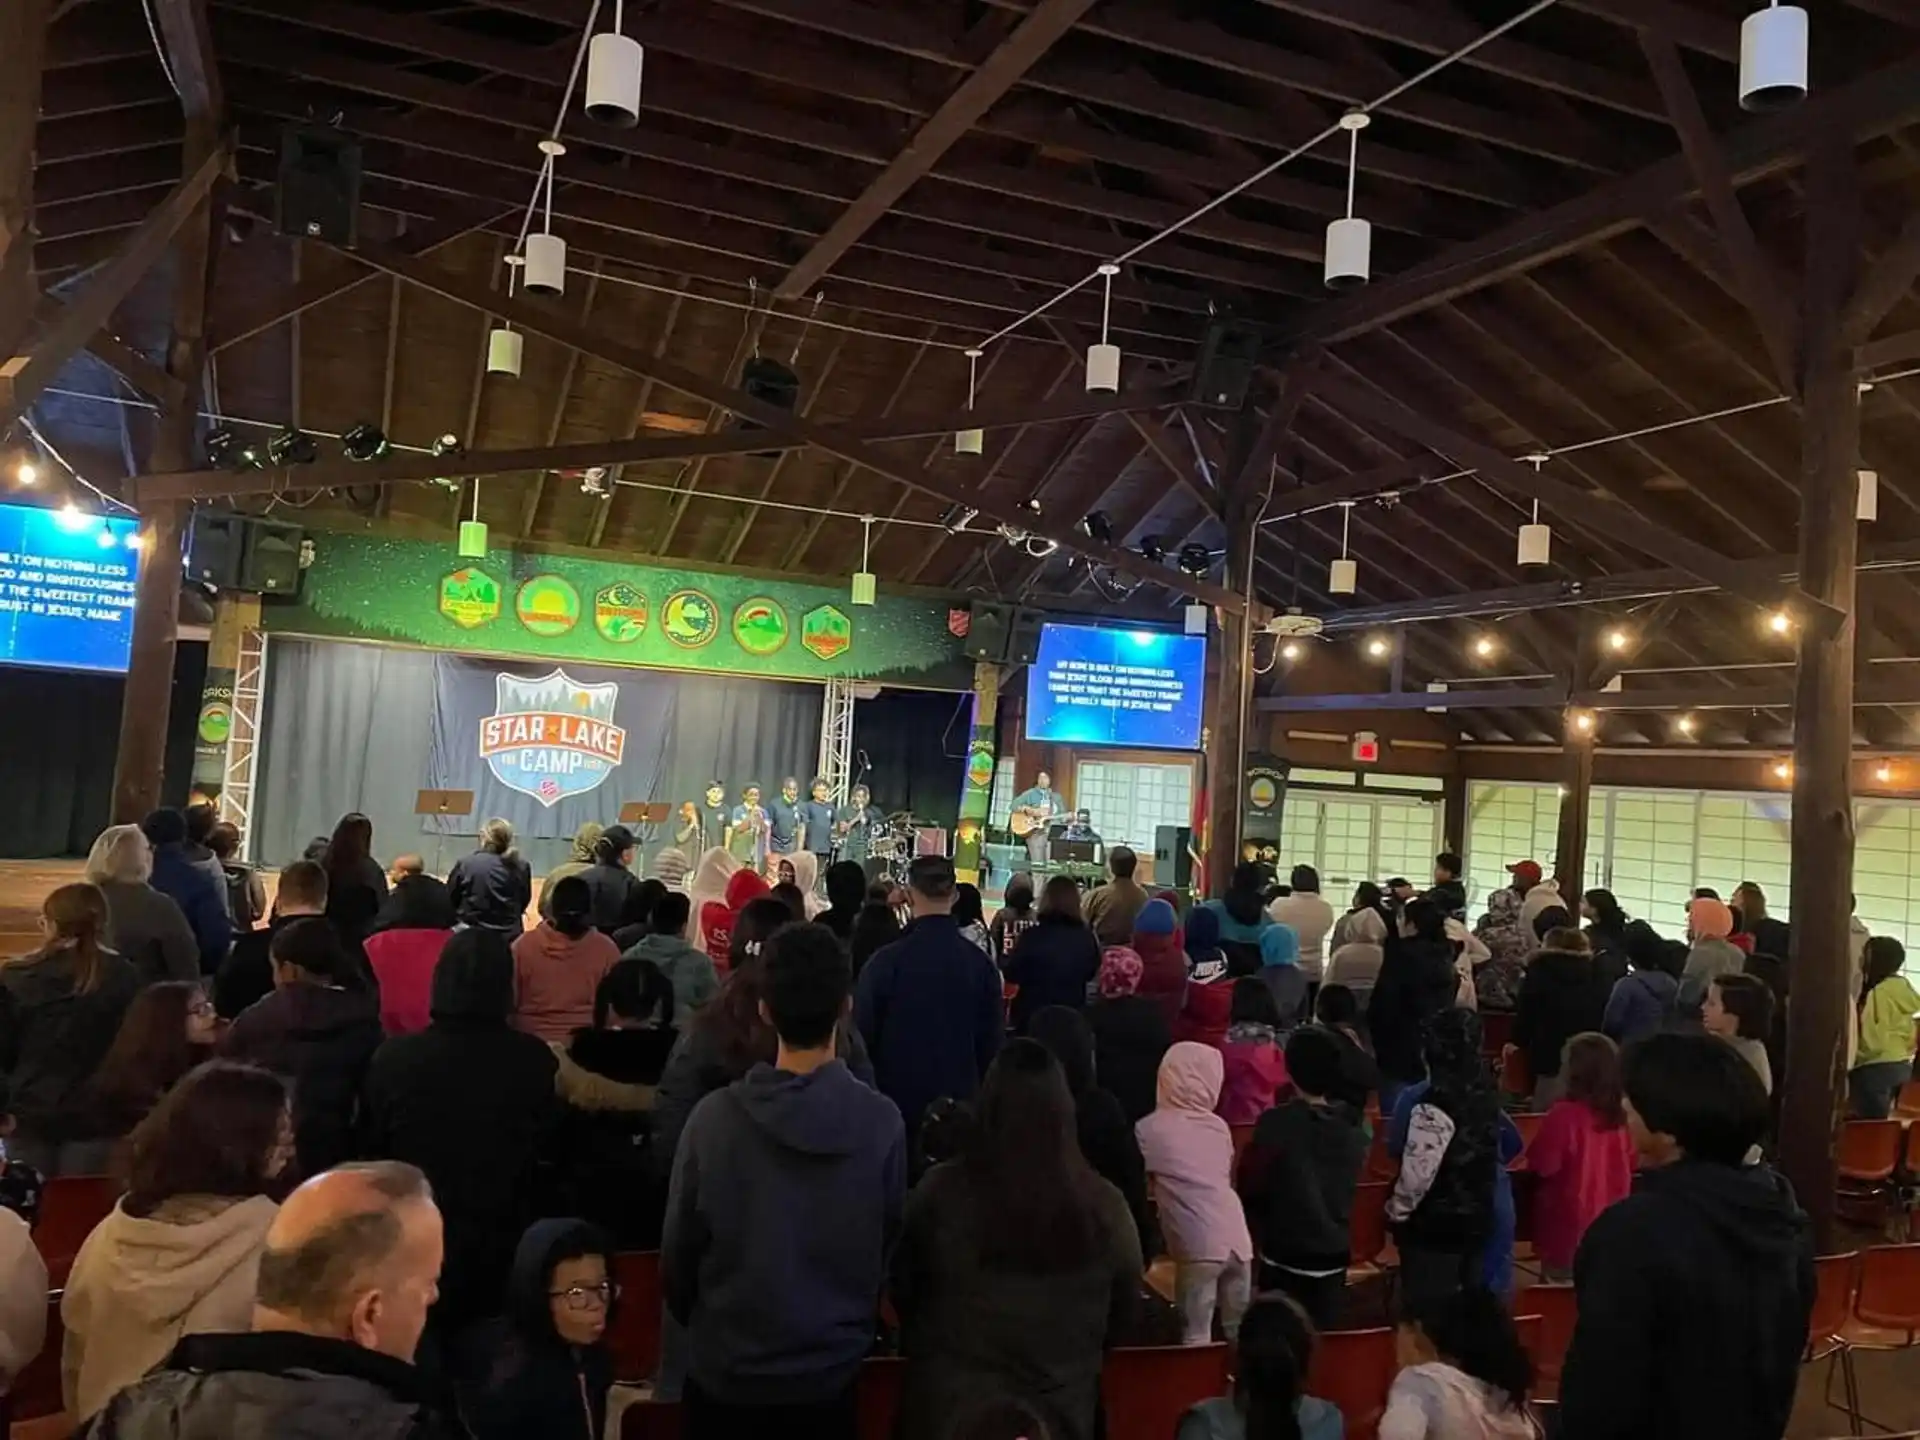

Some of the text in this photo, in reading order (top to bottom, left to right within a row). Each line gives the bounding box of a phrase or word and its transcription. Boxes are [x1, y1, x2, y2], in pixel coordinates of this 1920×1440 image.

[23, 555, 42, 567] ON
[43, 557, 96, 573] NOTHING
[97, 564, 128, 576] LESS
[19, 570, 44, 582] AND
[9, 584, 31, 596] THE
[33, 588, 96, 603] SWEETEST
[31, 602, 45, 613] IN
[87, 607, 121, 621] NAME
[487, 716, 619, 755] STAR LAKE
[520, 748, 582, 774] CAMP
